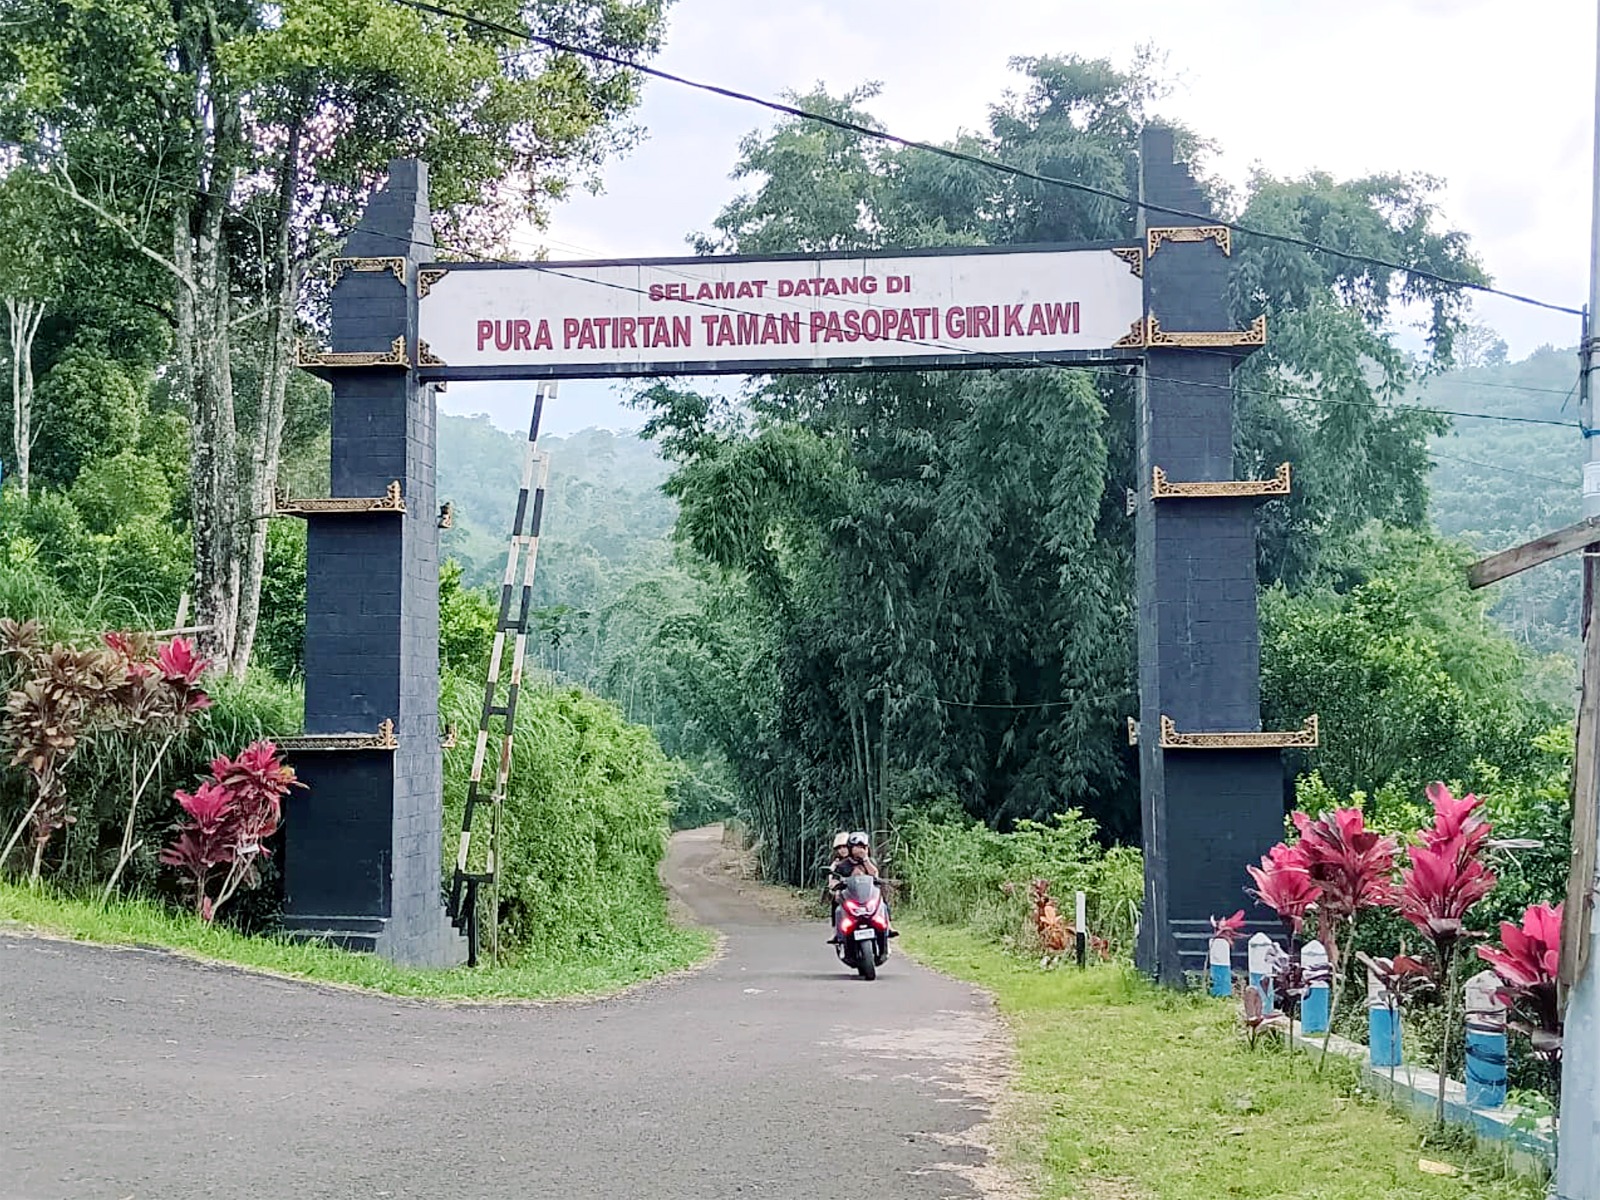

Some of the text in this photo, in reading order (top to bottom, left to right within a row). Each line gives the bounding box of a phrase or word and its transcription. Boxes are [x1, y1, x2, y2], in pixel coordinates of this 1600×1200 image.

[648, 275, 911, 302] SELAMAT DATANG DI
[476, 318, 553, 352] PURA
[563, 315, 692, 350] PATIRTAN
[701, 312, 800, 347] TAMAN
[809, 306, 939, 344] PASOPATI
